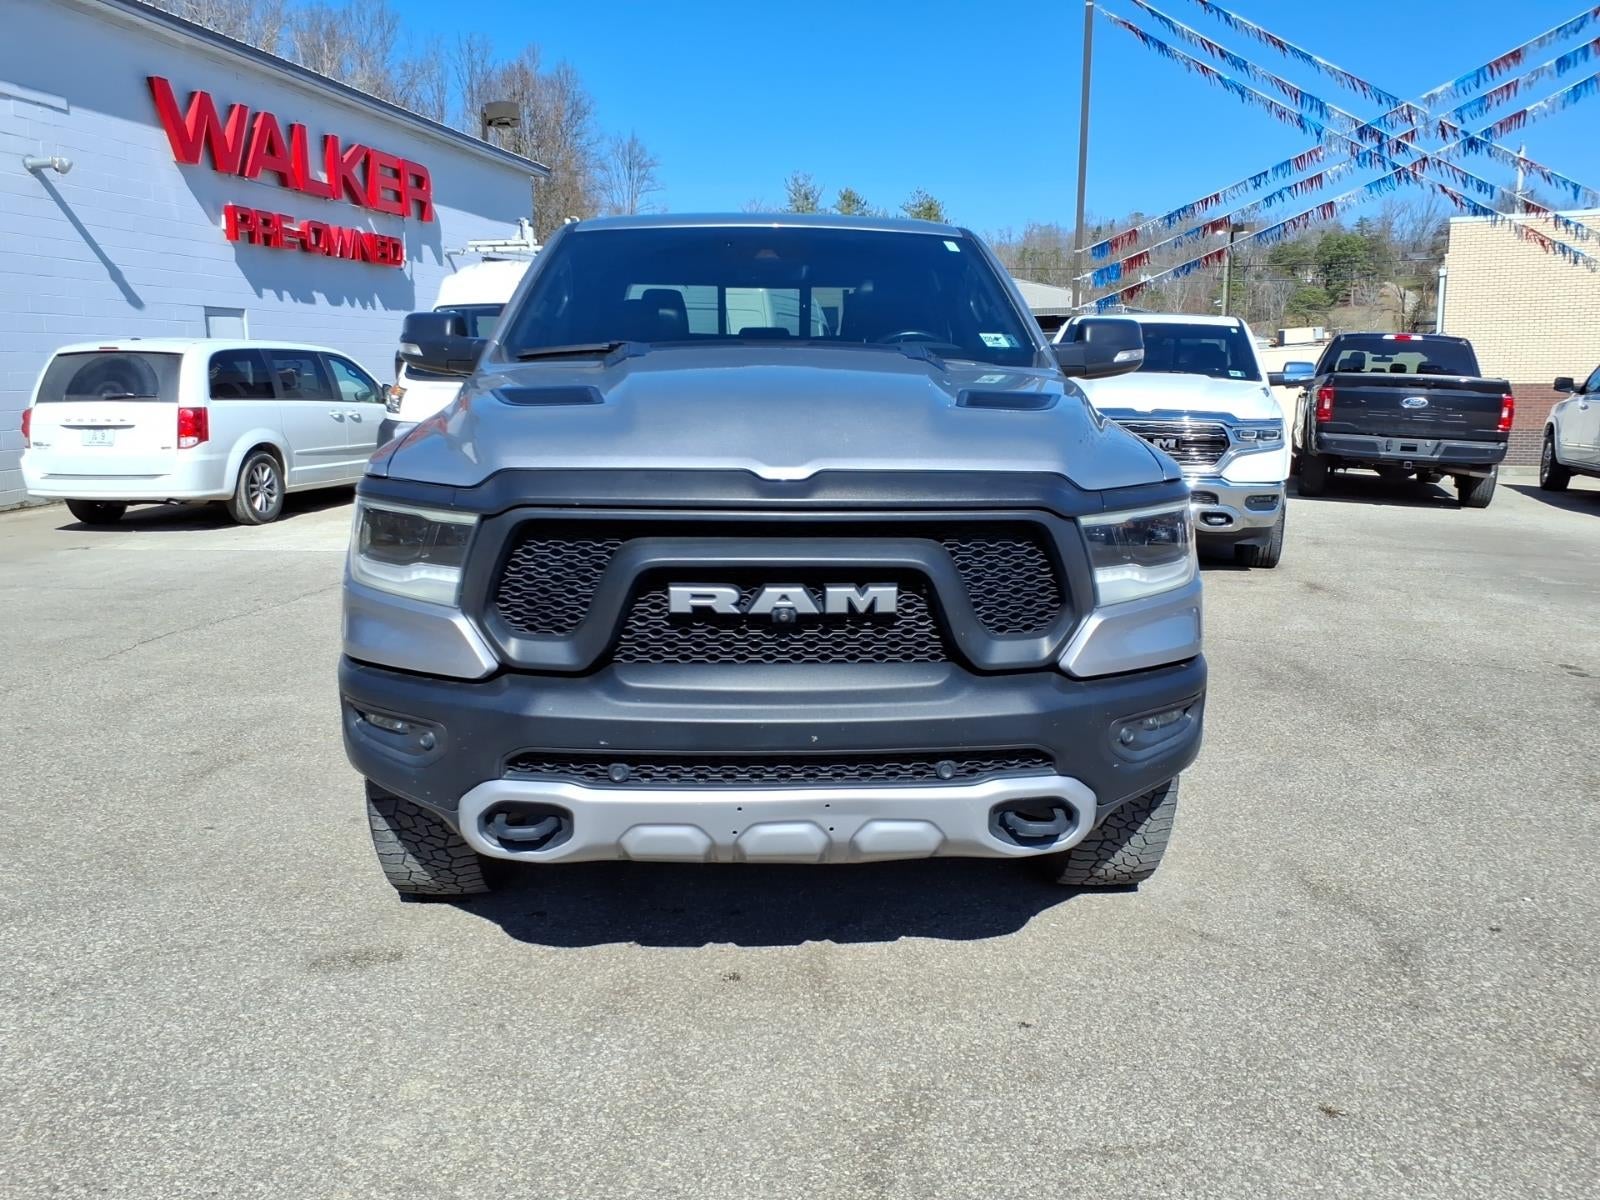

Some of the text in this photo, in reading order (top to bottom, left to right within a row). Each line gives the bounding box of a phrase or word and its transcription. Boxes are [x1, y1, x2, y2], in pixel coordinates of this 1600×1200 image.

[147, 75, 434, 222] WALKER
[222, 204, 405, 267] PRE-OWNED
[668, 584, 898, 615] RAM
